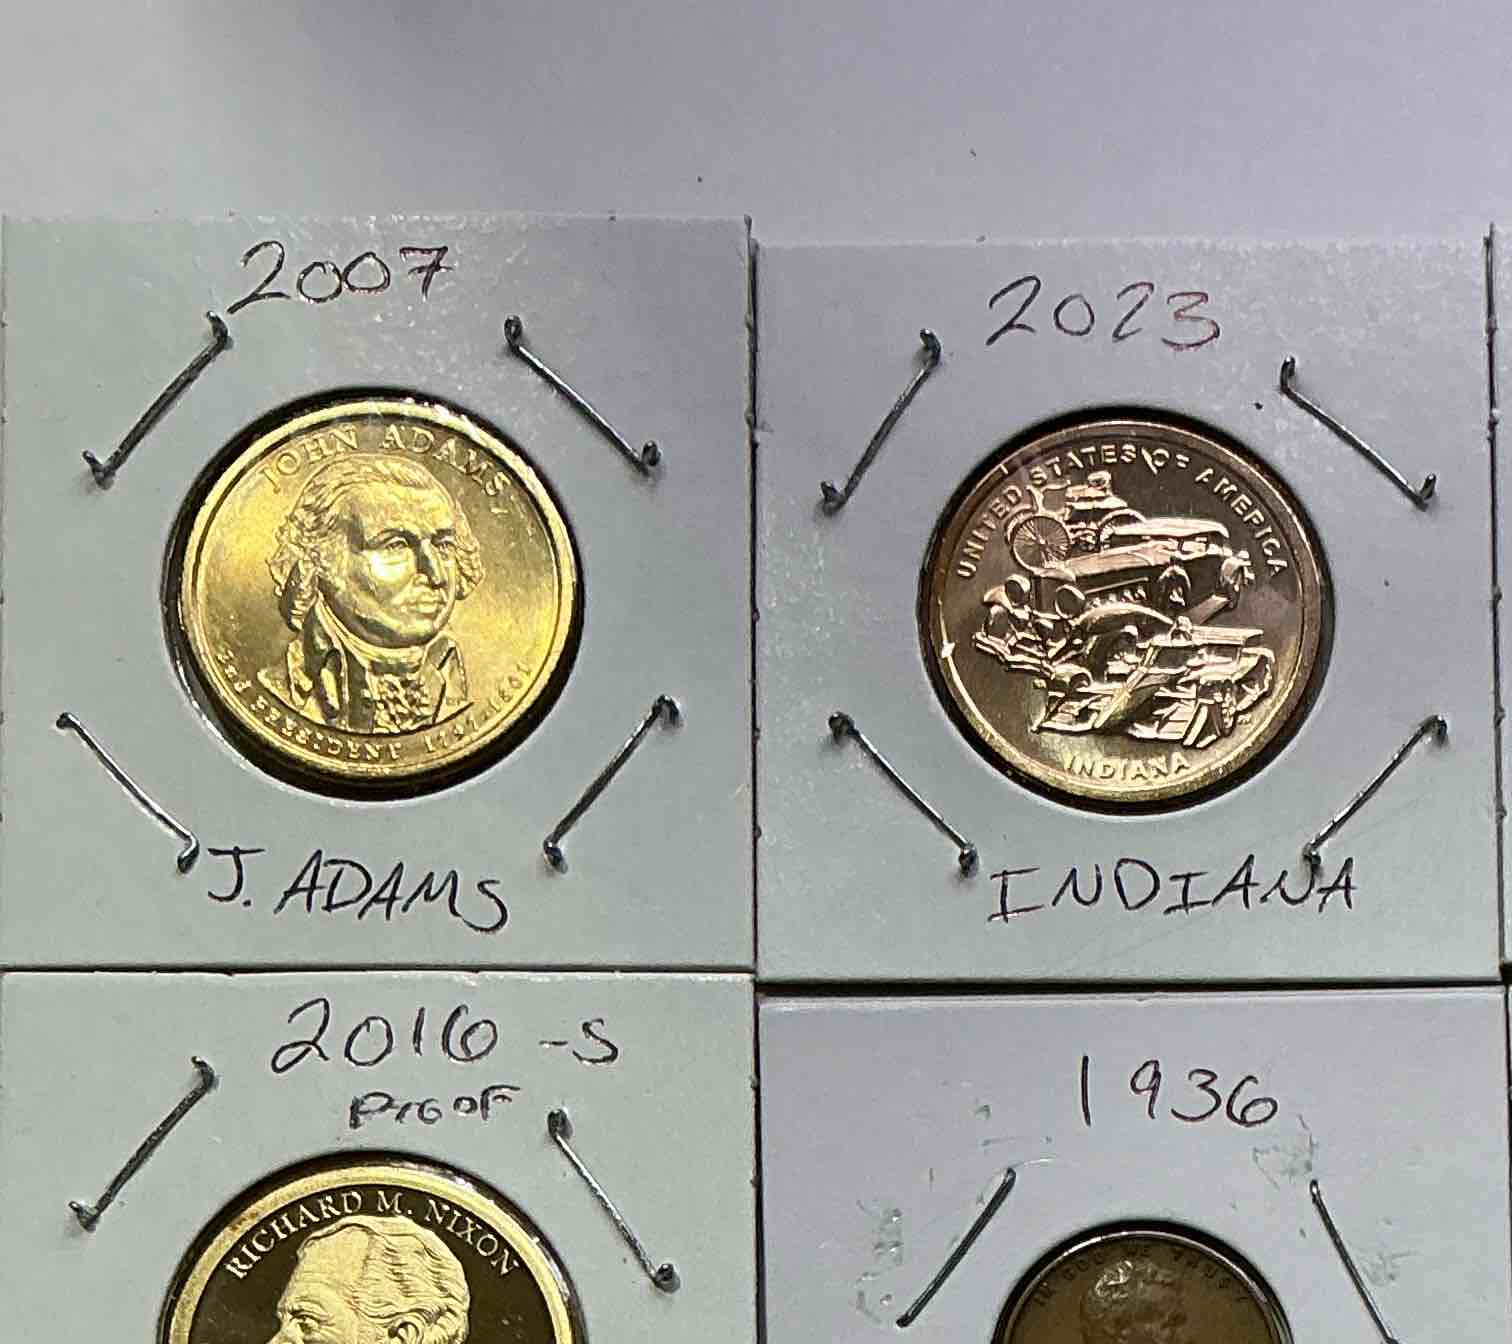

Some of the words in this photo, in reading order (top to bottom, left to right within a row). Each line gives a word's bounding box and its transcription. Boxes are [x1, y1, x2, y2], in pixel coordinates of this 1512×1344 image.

[227, 240, 451, 315] 2007
[986, 275, 1222, 351] 2023
[258, 427, 360, 494] JOHN
[378, 423, 513, 498] ADAMS
[956, 486, 1023, 580] UNITED
[1031, 443, 1138, 487] STATES
[1195, 467, 1290, 578] AMERICA
[1066, 753, 1191, 783] INDIANA
[206, 845, 263, 909] J.
[273, 848, 509, 932] ADAMS
[986, 854, 1358, 923] INDIANA
[271, 997, 499, 1075] 2016
[1079, 1054, 1280, 1127] 1936
[224, 1190, 363, 1280] RICHARD
[376, 1189, 413, 1217] M.
[426, 1198, 522, 1277] NIXON
